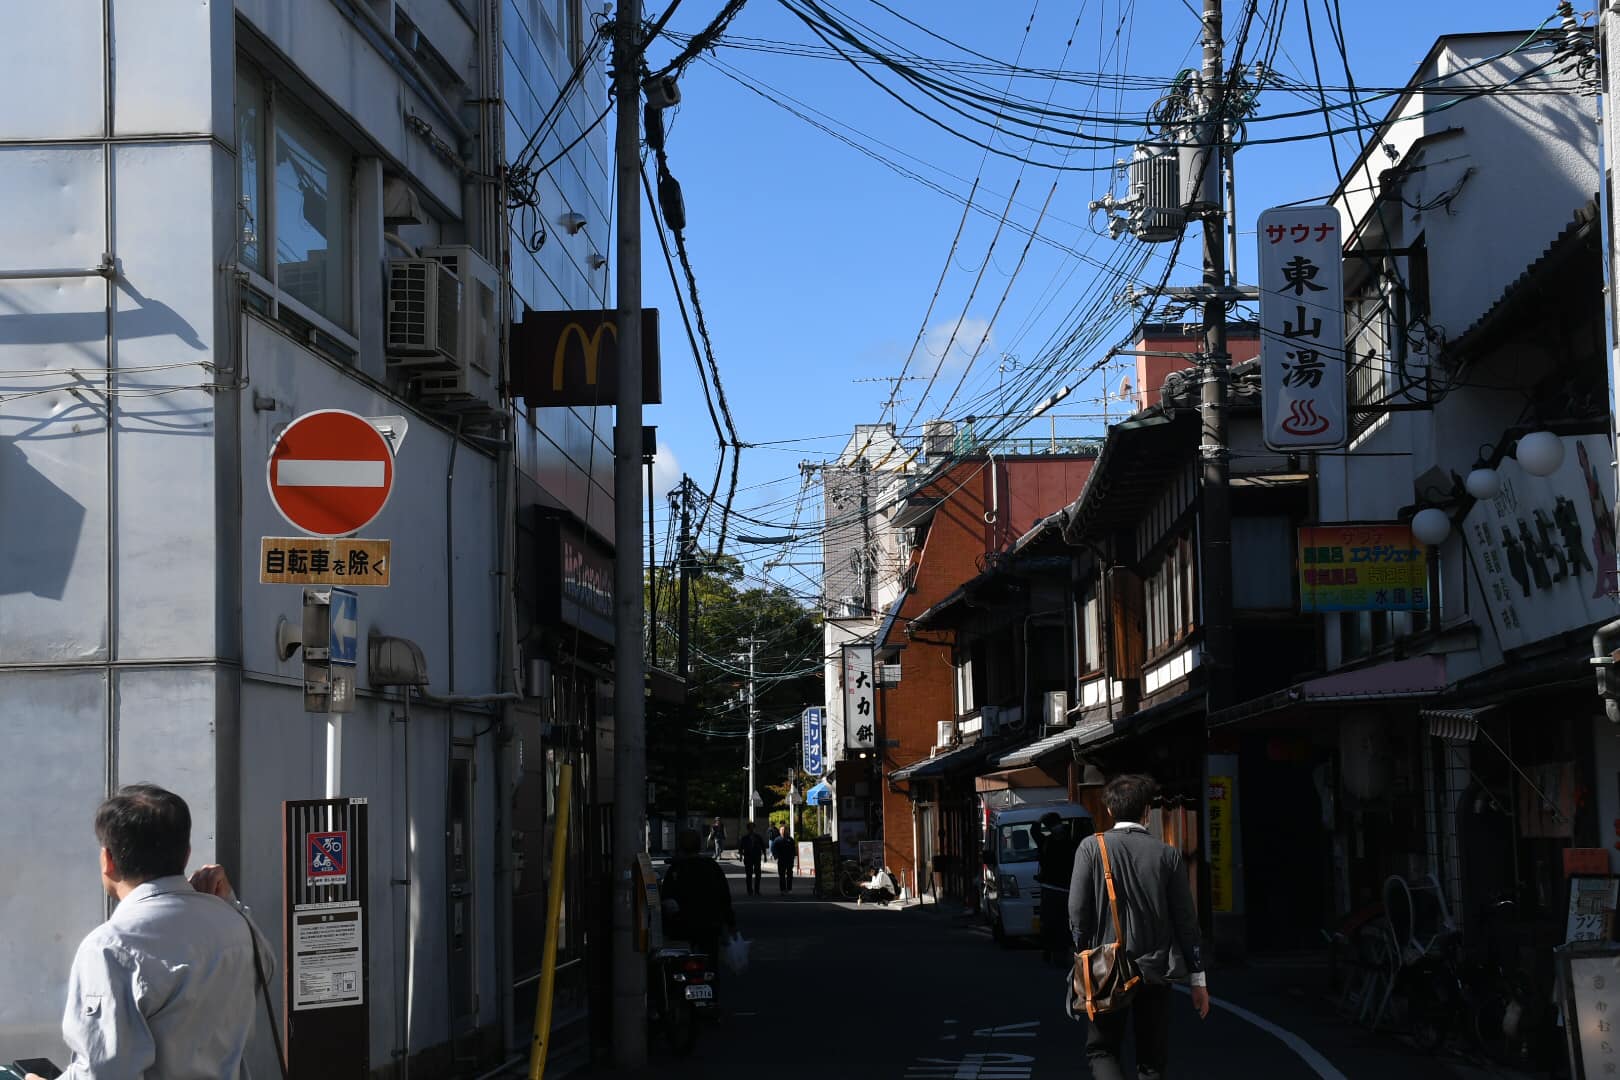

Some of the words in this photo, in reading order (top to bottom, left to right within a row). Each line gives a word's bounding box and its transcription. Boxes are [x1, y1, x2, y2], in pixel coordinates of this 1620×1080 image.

[1266, 223, 1335, 244] サウナ
[1279, 255, 1328, 389] 東山湯
[266, 548, 384, 576] 自転車を除く
[855, 671, 873, 742] 大力餅
[810, 713, 820, 771] ミリオン
